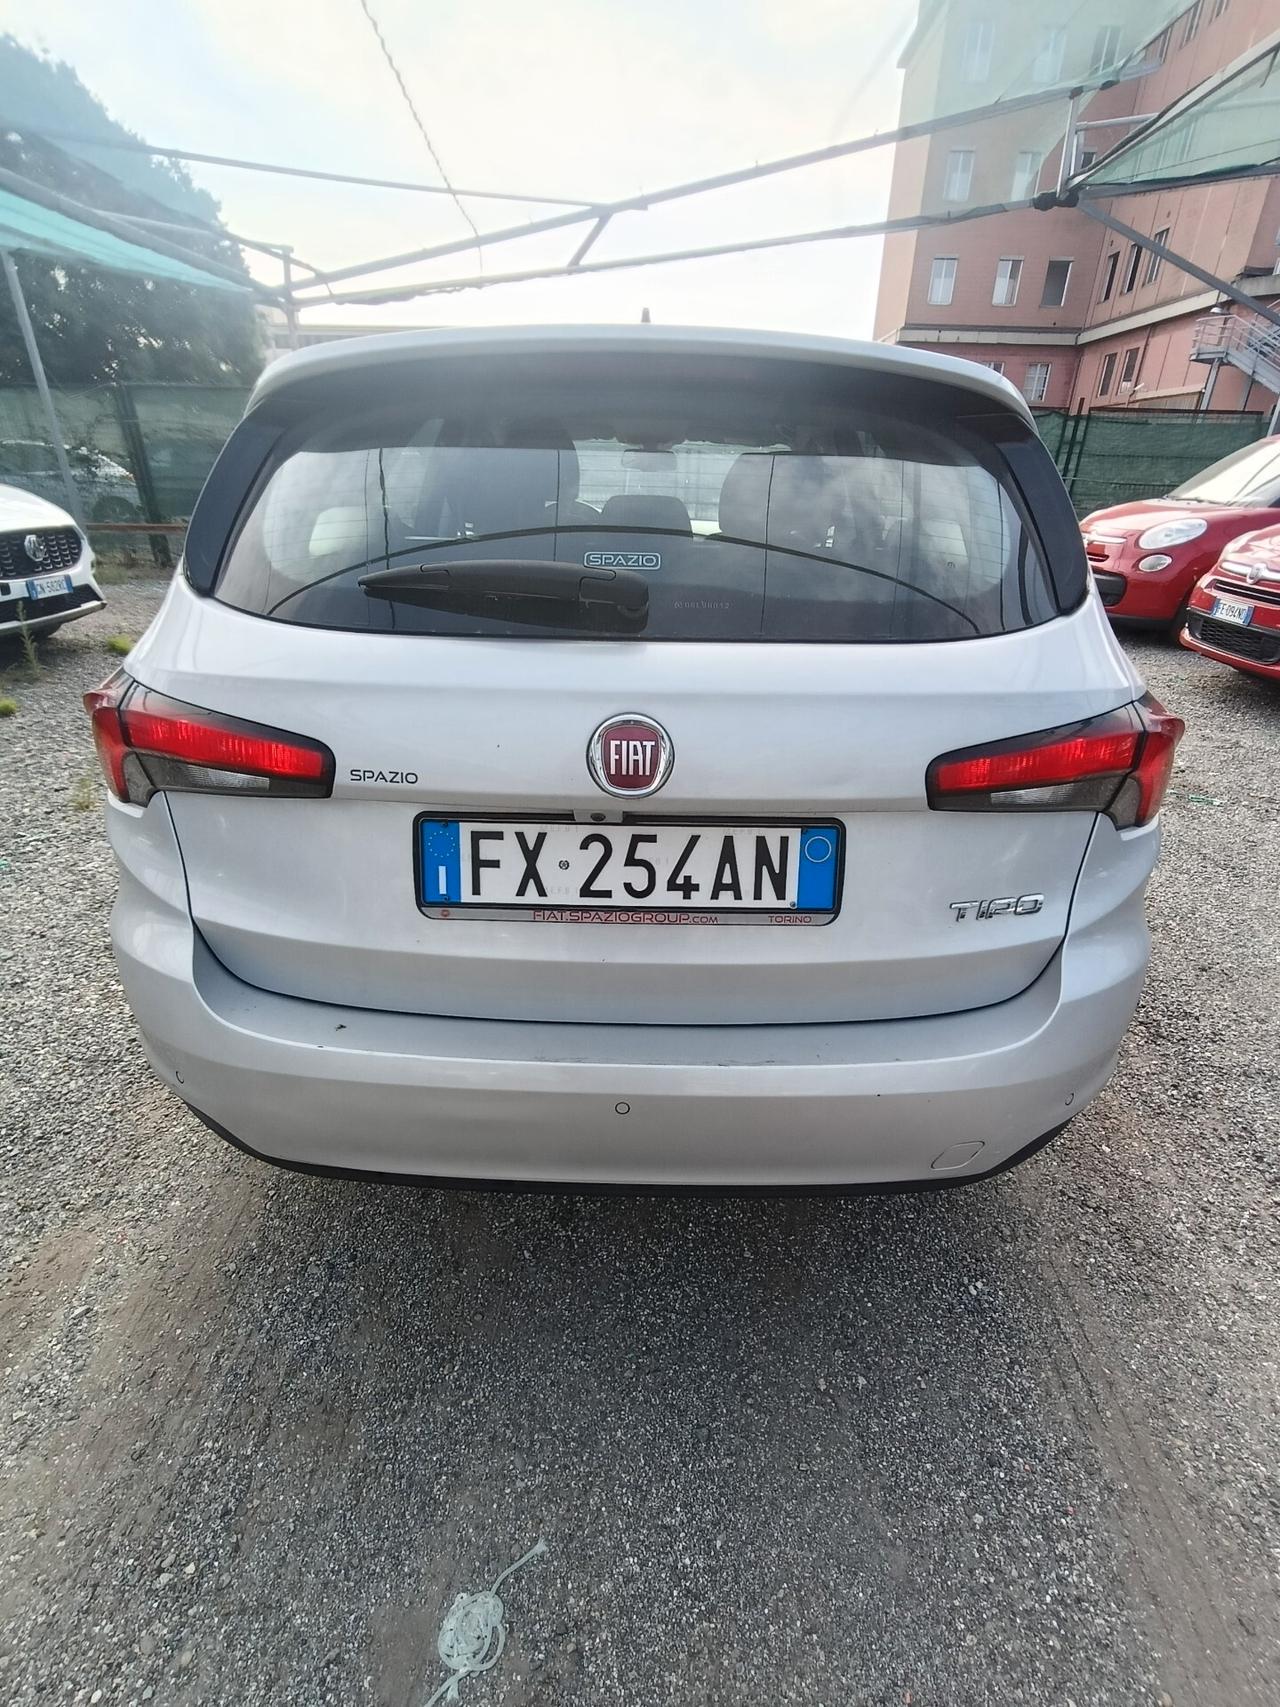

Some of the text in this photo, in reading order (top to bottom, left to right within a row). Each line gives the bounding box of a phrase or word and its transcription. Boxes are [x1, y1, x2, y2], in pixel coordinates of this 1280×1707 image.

[588, 554, 657, 566] SPAZIO
[610, 740, 656, 776] FIAT
[350, 769, 419, 784] SPAZIO
[470, 831, 790, 900] FX 254AN
[949, 893, 1045, 922] TIPO
[768, 915, 812, 924] TORINO
